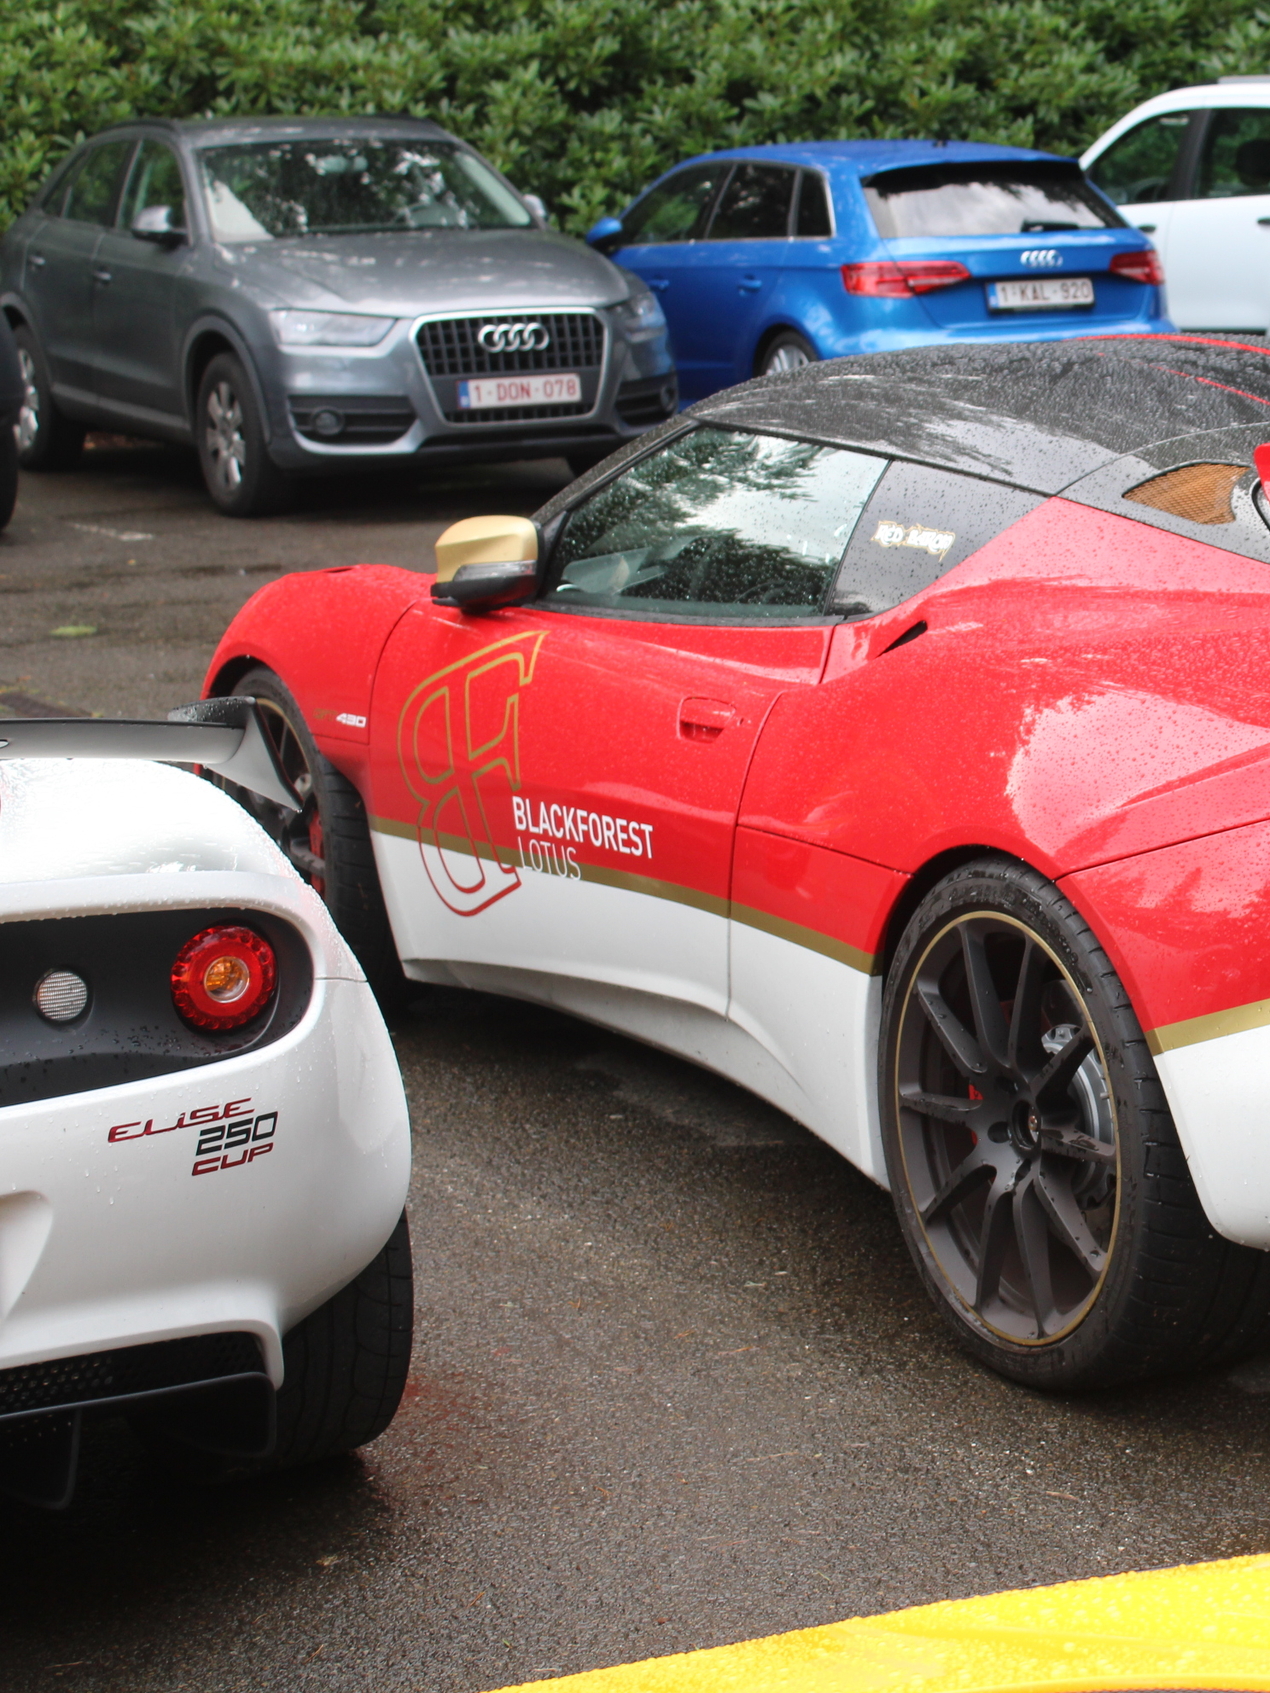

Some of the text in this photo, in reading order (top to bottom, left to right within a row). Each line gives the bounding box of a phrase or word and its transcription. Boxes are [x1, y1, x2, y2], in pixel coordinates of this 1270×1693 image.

[512, 796, 653, 859] BLACKFOREST
[517, 836, 582, 881] LOTUS
[195, 1111, 278, 1156] 250
[191, 1142, 274, 1176] CUP
